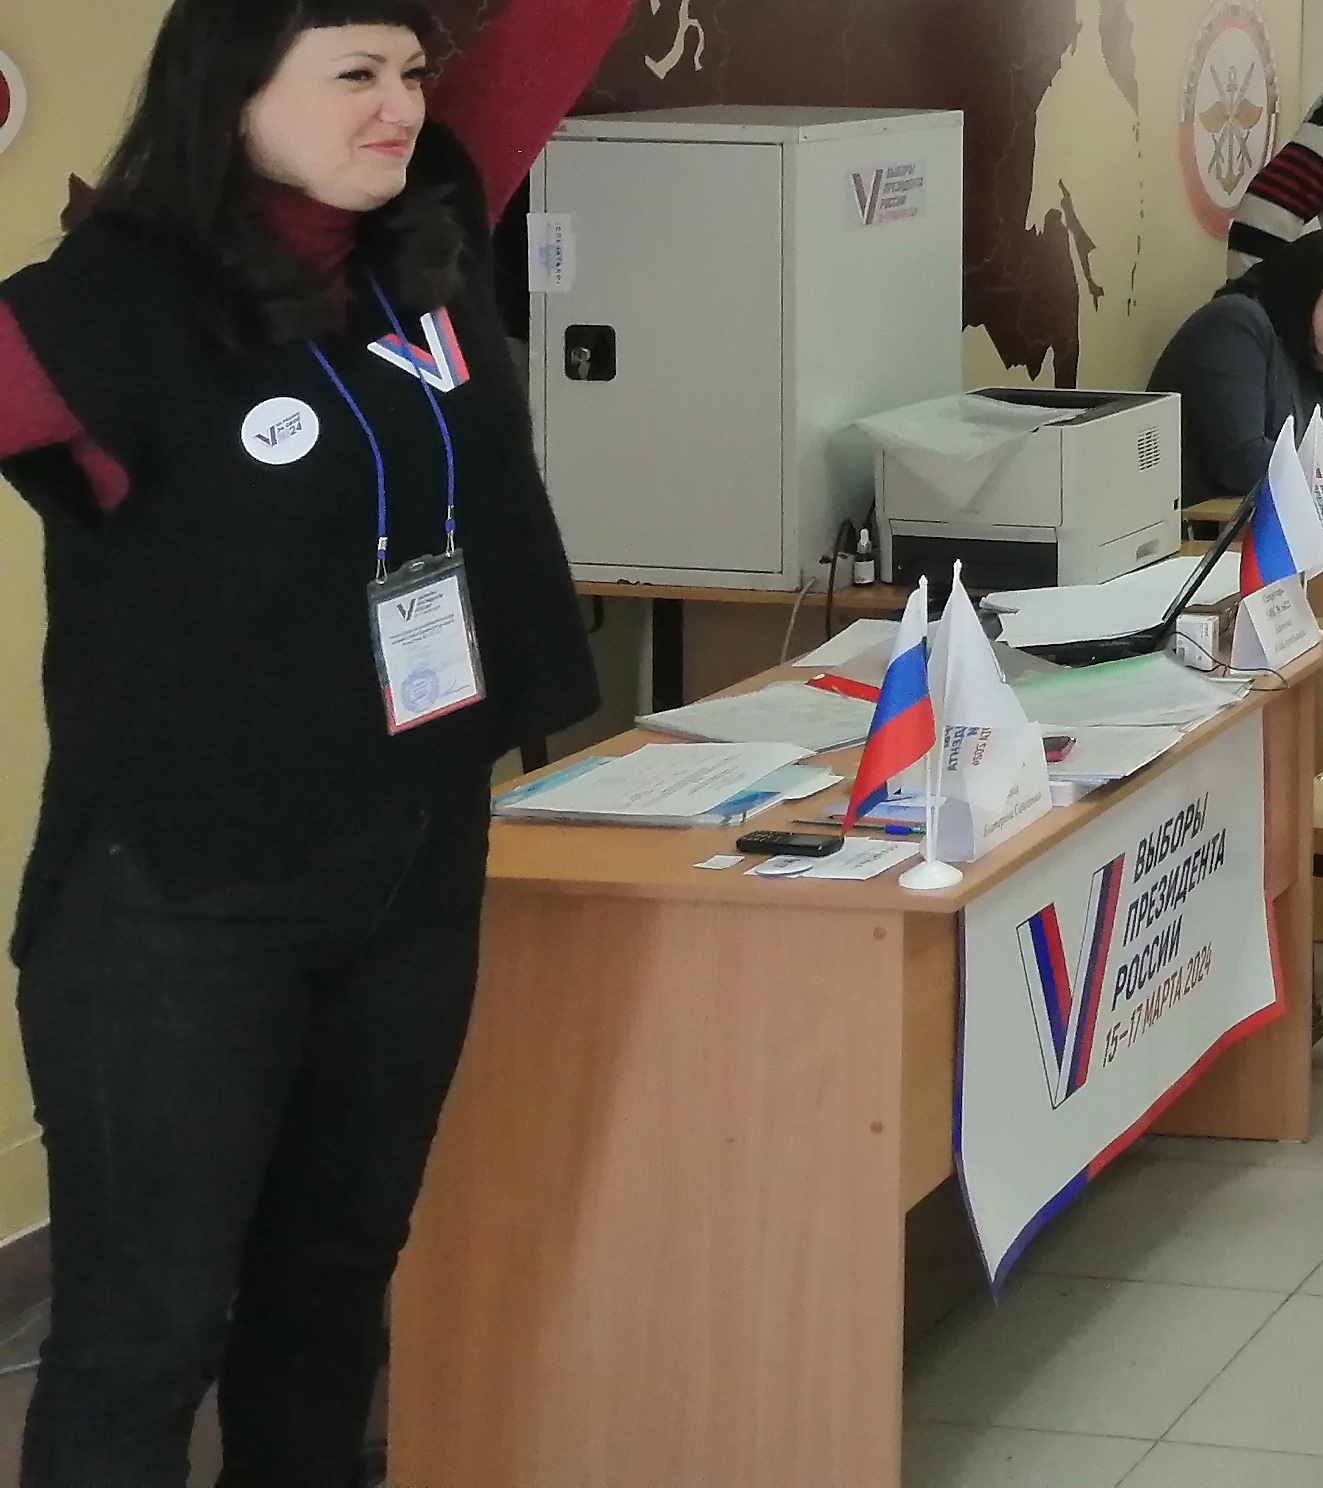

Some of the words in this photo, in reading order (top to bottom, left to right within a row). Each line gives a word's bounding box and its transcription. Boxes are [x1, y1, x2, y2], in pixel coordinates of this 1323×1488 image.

[1133, 792, 1208, 884] ВЫБОРЫ
[1122, 828, 1226, 947] ПРЕЗИДЕНТА
[1111, 914, 1183, 1012] РОССИИ
[1142, 966, 1183, 1034] МАРТА
[1184, 941, 1212, 995] 2024
